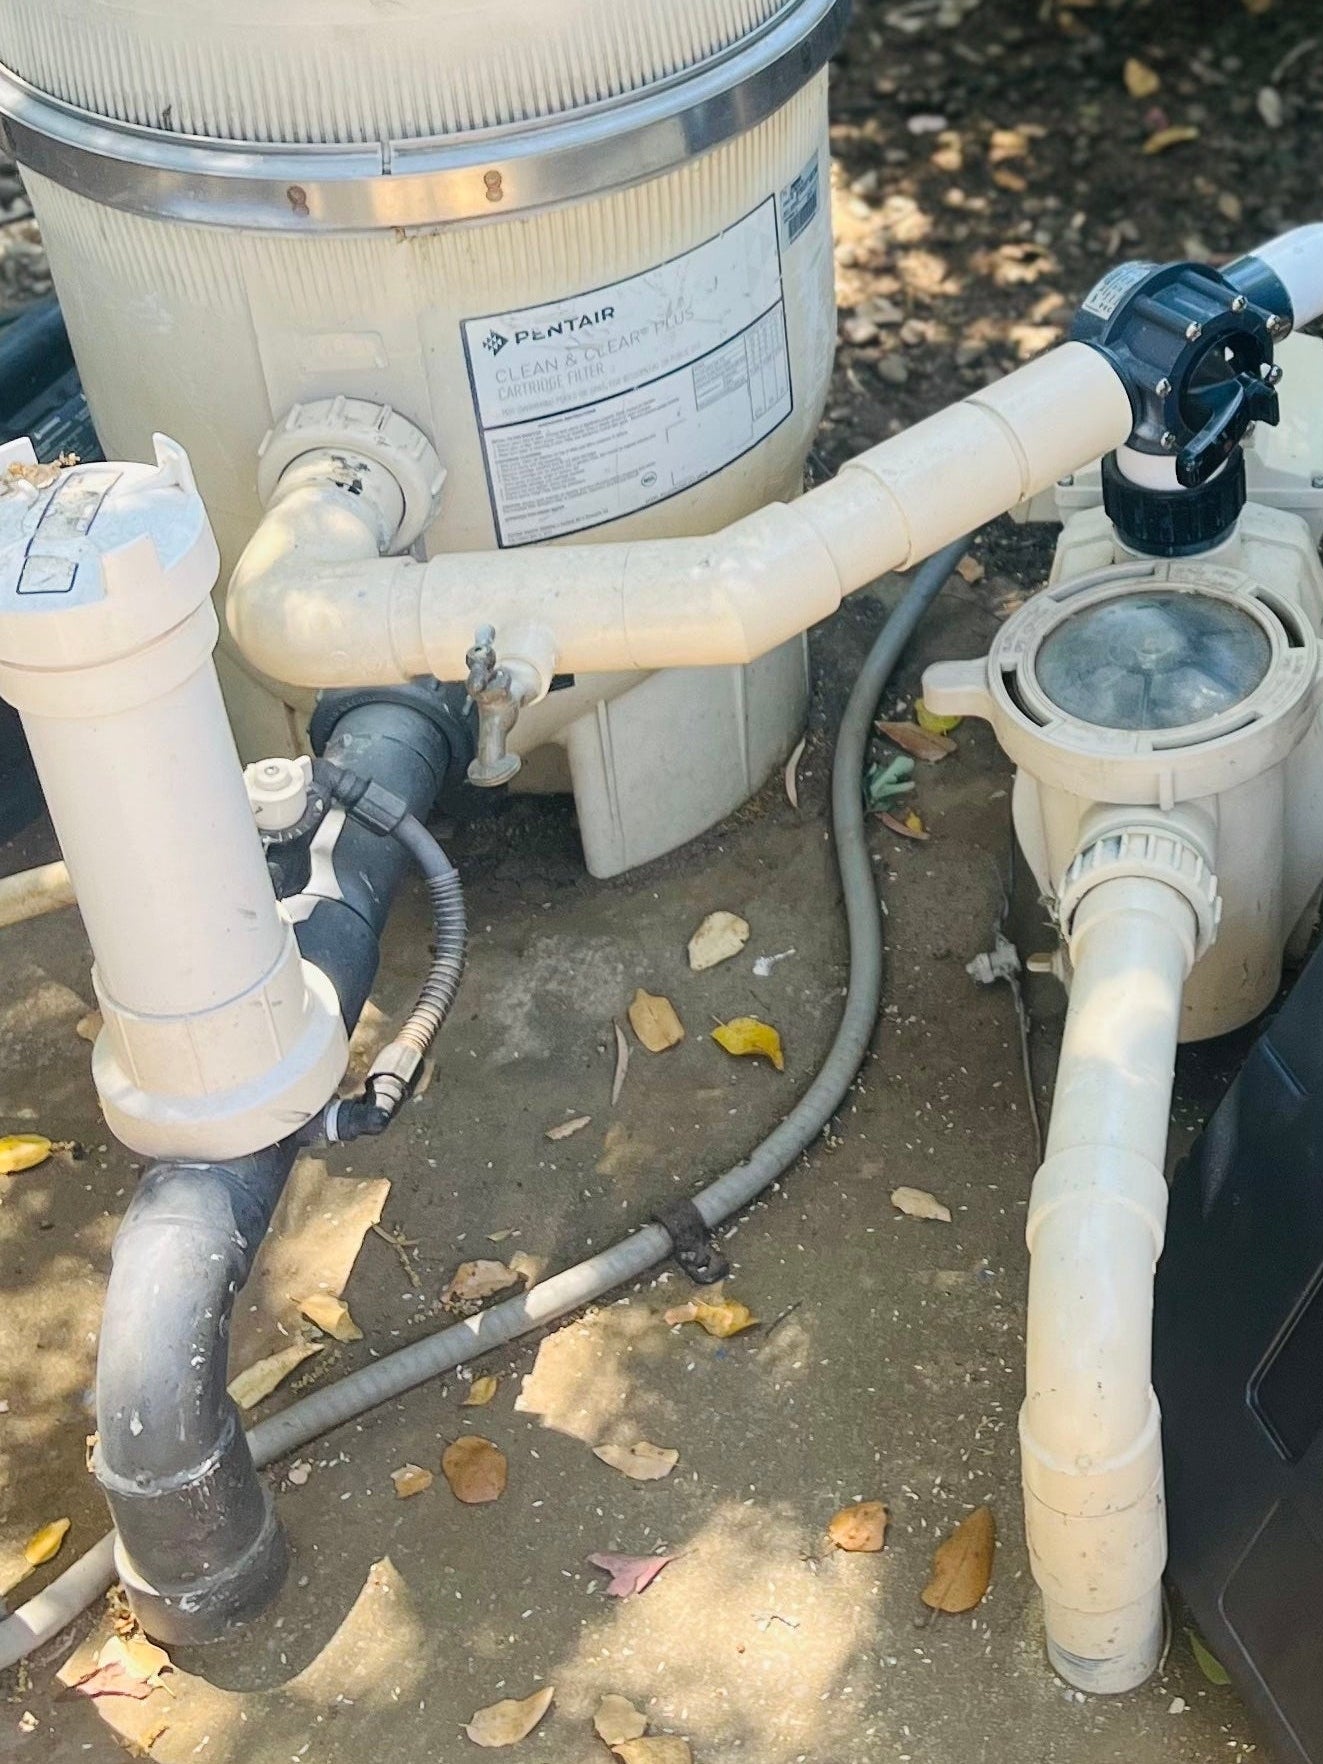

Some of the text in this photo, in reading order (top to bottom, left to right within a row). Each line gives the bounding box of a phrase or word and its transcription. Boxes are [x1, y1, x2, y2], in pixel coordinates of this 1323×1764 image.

[515, 307, 615, 344] PENTAIR
[495, 356, 558, 384] CLEAN
[565, 353, 577, 368] &
[653, 309, 694, 335] PLUS
[498, 365, 604, 401] CARTRIDGE FILTER
